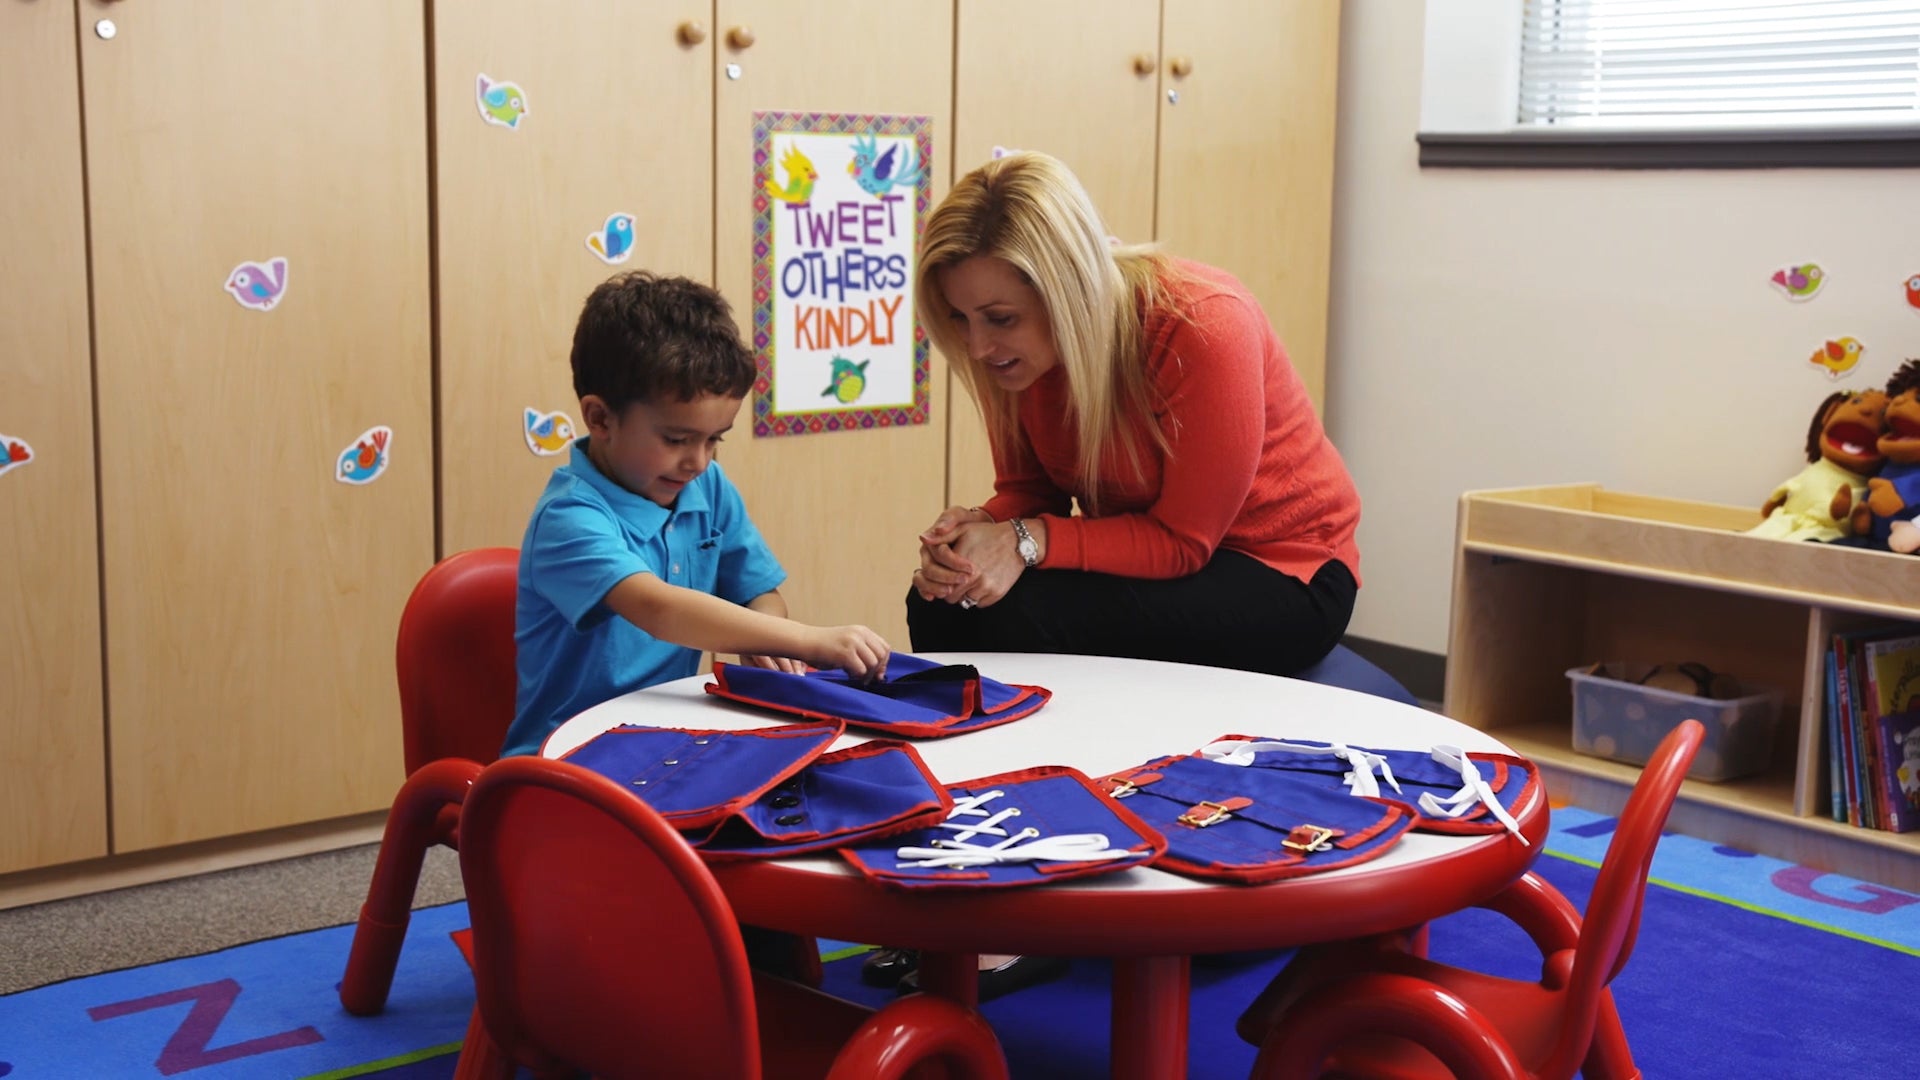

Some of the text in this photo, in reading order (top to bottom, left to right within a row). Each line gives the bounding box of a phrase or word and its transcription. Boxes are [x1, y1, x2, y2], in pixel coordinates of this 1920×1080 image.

[785, 195, 904, 248] TWEET
[781, 248, 906, 302] OTHERS
[795, 295, 904, 350] KINDLY
